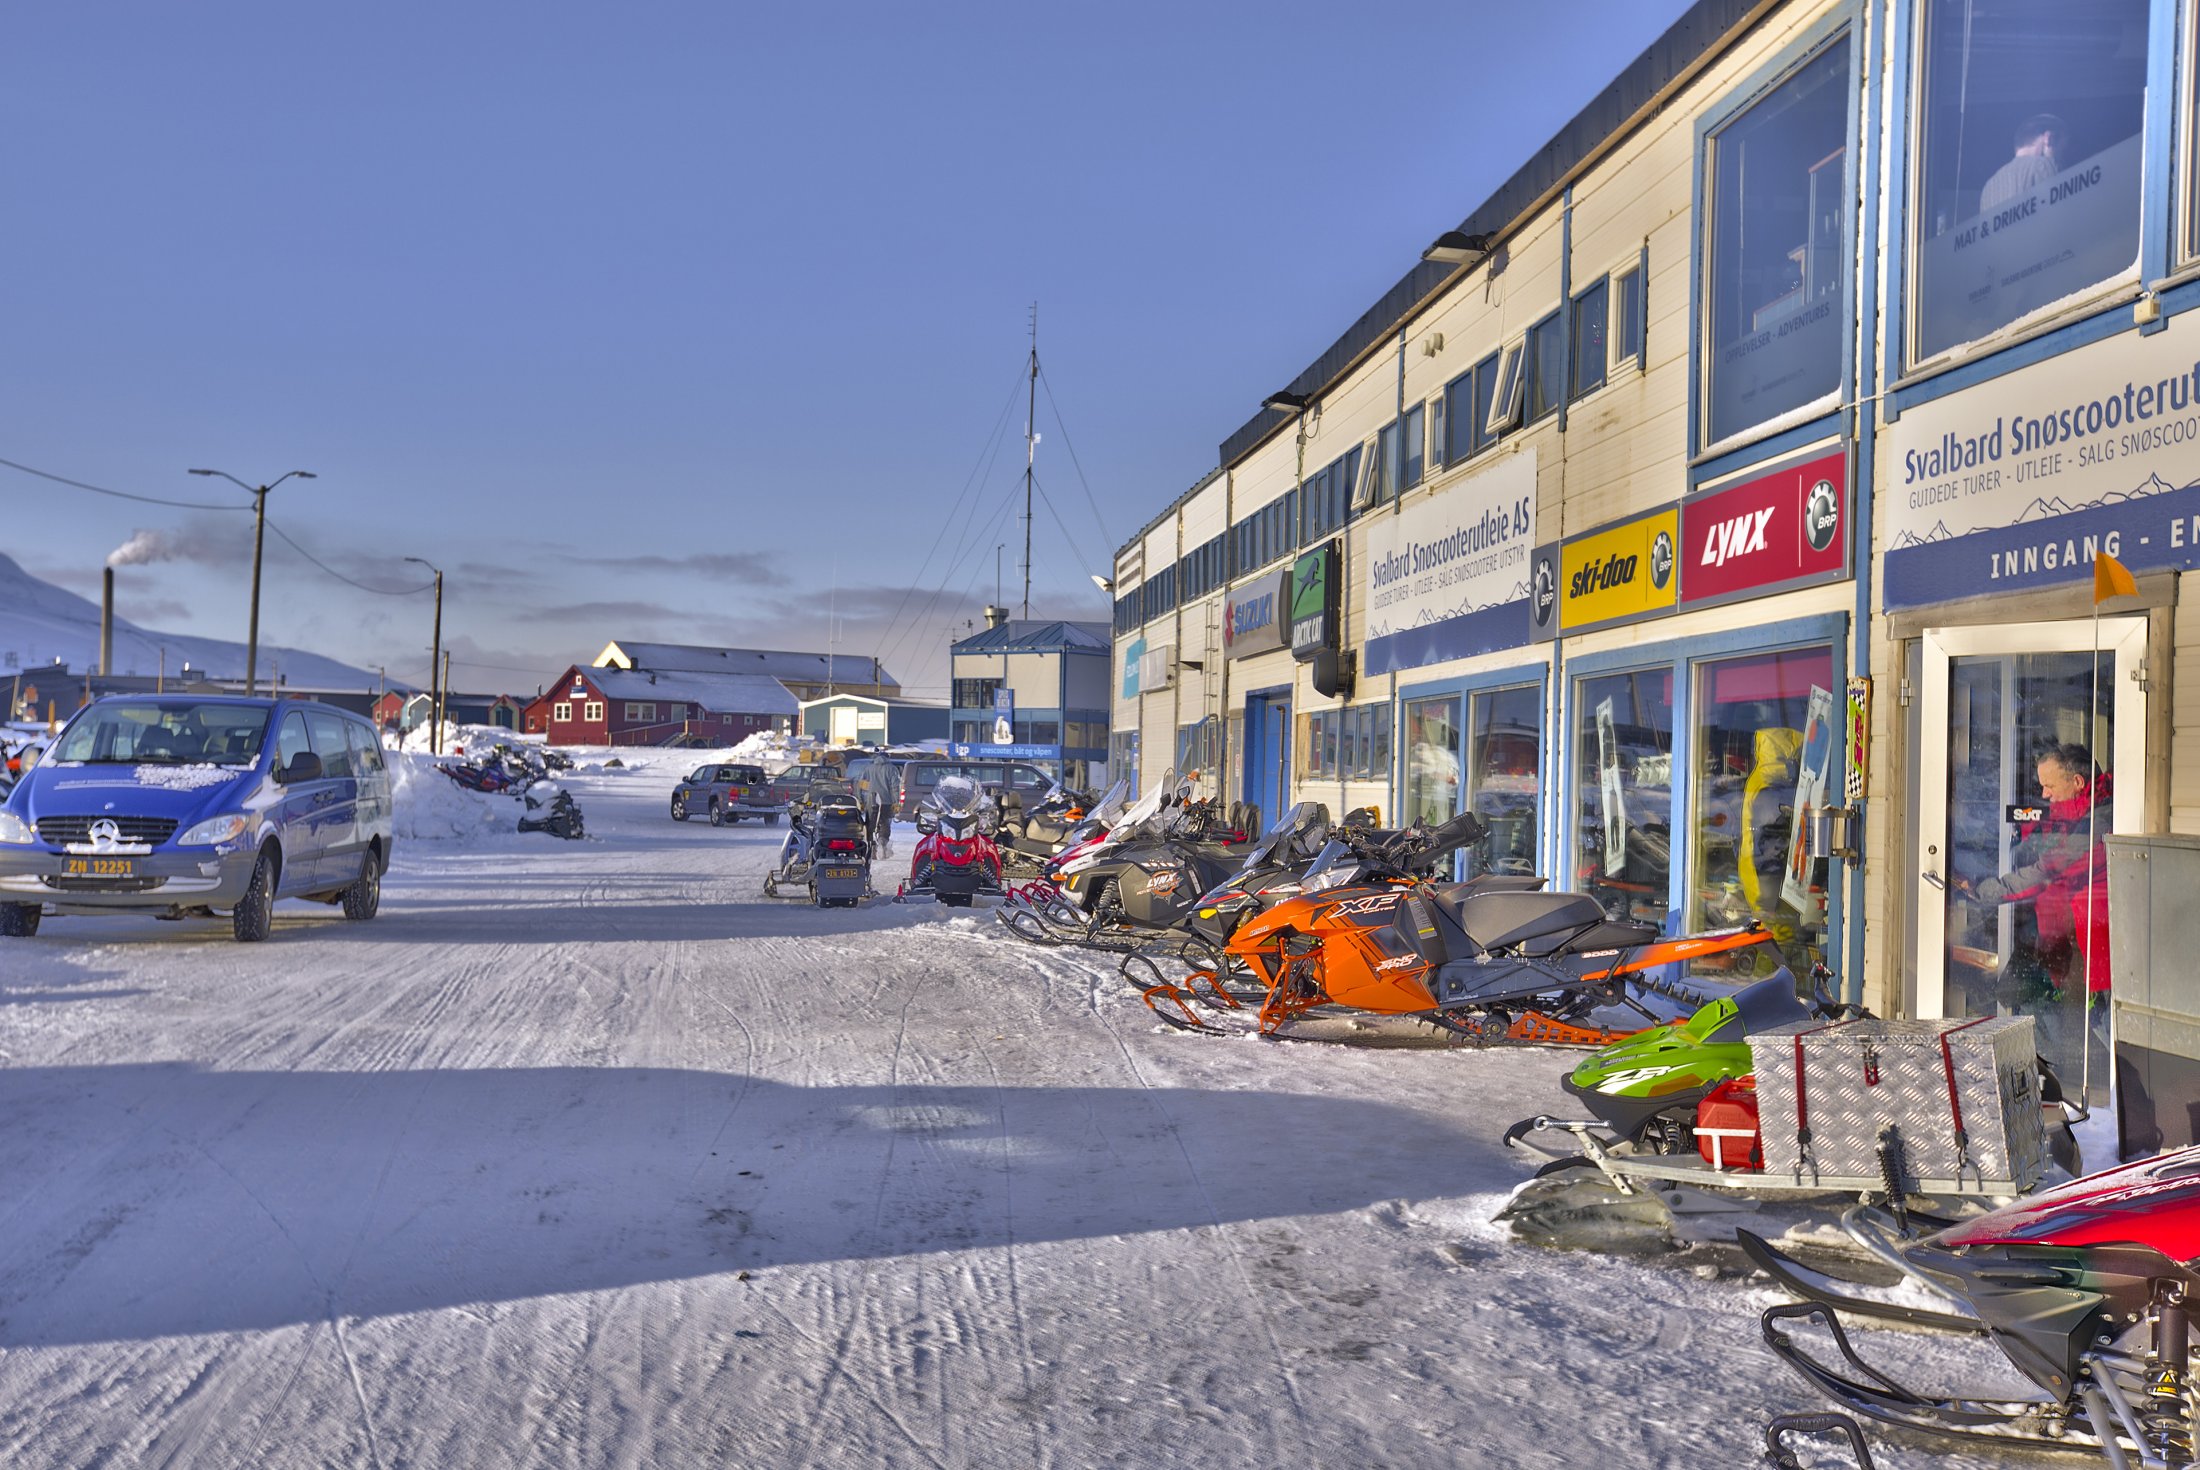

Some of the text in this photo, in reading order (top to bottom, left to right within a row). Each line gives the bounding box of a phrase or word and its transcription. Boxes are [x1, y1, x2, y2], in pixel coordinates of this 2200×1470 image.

[1954, 226, 1978, 252] MAT
[1980, 220, 1990, 239] &
[1993, 196, 2037, 233] DRIKKE
[2050, 164, 2101, 205] DINING
[1777, 301, 1831, 339] ADVENTURES
[1904, 416, 2003, 486] Svalbard
[1909, 483, 1958, 510] GUIDEDE
[1963, 470, 2002, 497] TURER
[2016, 453, 2063, 484] UTLEIE
[2079, 439, 2115, 468] SALG
[2121, 414, 2200, 457] SNØSCOO
[1700, 506, 1775, 568] LYNX
[1817, 513, 1837, 531] BRP
[1373, 542, 1410, 590] Svalbard
[1512, 496, 1529, 538] AS
[1991, 531, 2121, 580] INNGANG
[1414, 575, 1433, 598] UTLEIE
[1438, 568, 1453, 590] SALG
[1499, 543, 1525, 569] UTSTYR
[1569, 552, 1638, 600] ski-doo
[1658, 560, 1672, 572] BRP
[1234, 591, 1274, 636] SUZUKI
[1540, 592, 1554, 607] BRP
[1292, 615, 1323, 650] ARCTIC CAT
[2013, 807, 2043, 821] SIXT
[93, 860, 132, 874] 12251
[1146, 872, 1178, 888] LYNX
[1328, 893, 1401, 919] XF
[1597, 1065, 1673, 1089] ZR
